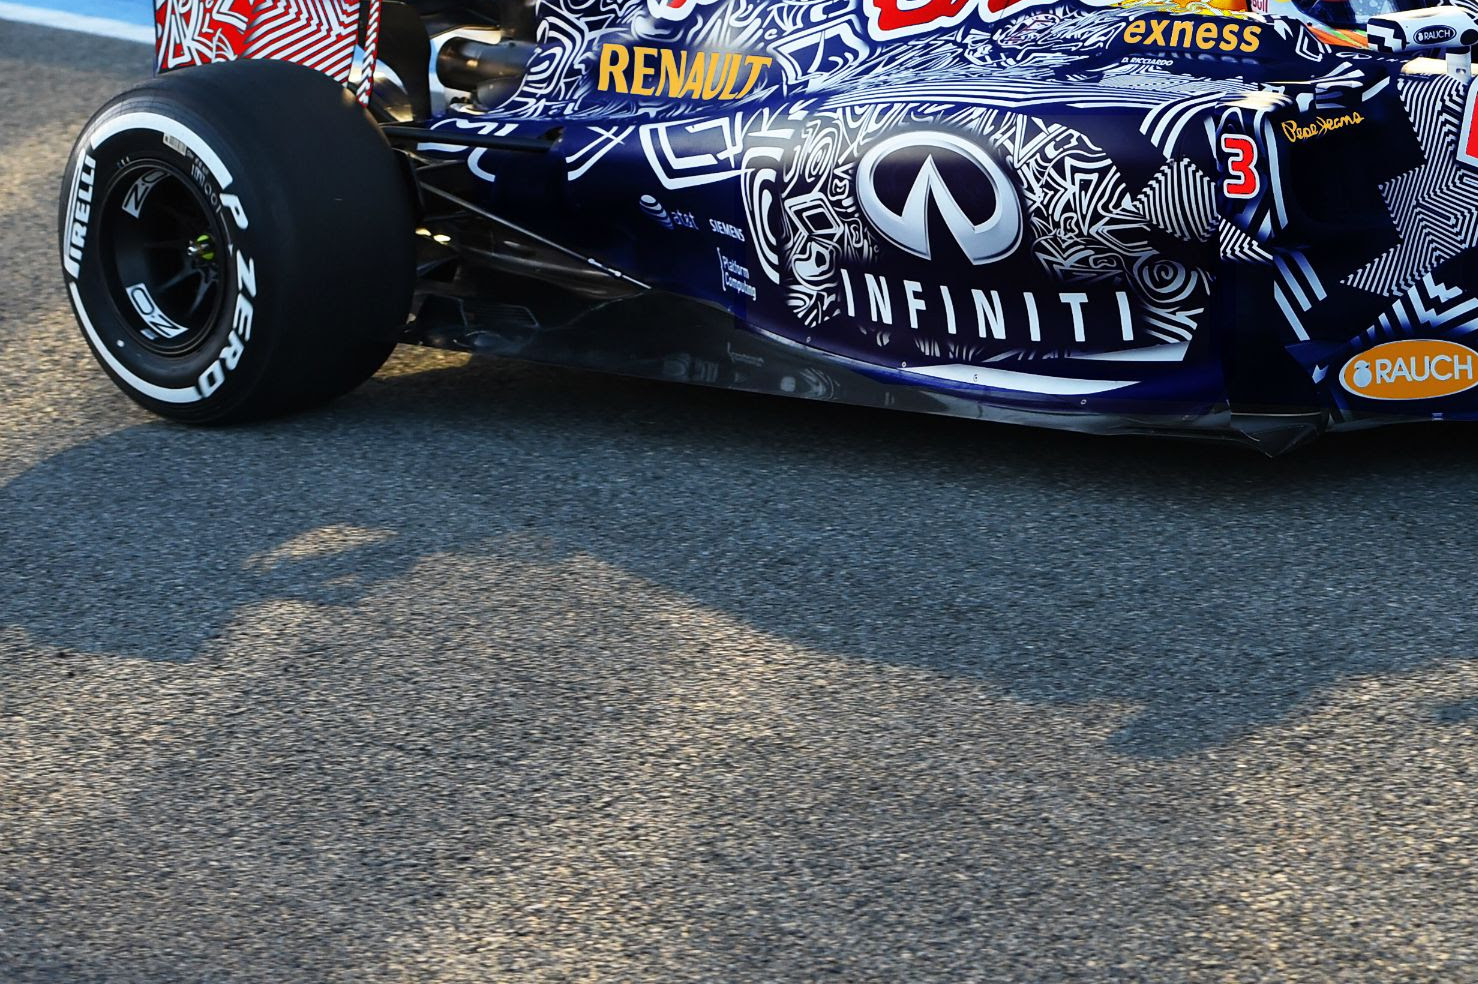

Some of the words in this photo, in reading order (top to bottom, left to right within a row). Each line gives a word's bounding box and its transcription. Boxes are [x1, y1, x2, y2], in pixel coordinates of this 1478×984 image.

[1123, 18, 1262, 52] exness
[1424, 29, 1451, 41] RAUCH
[597, 43, 772, 101] RENAULT
[1131, 57, 1174, 67] RICCIARDO
[1221, 133, 1261, 198] 3
[219, 193, 249, 230] P
[709, 218, 745, 242] SIEMENS
[840, 268, 1134, 342] INFINITI
[197, 249, 257, 398] ZERO
[1375, 354, 1474, 384] RAUCH
